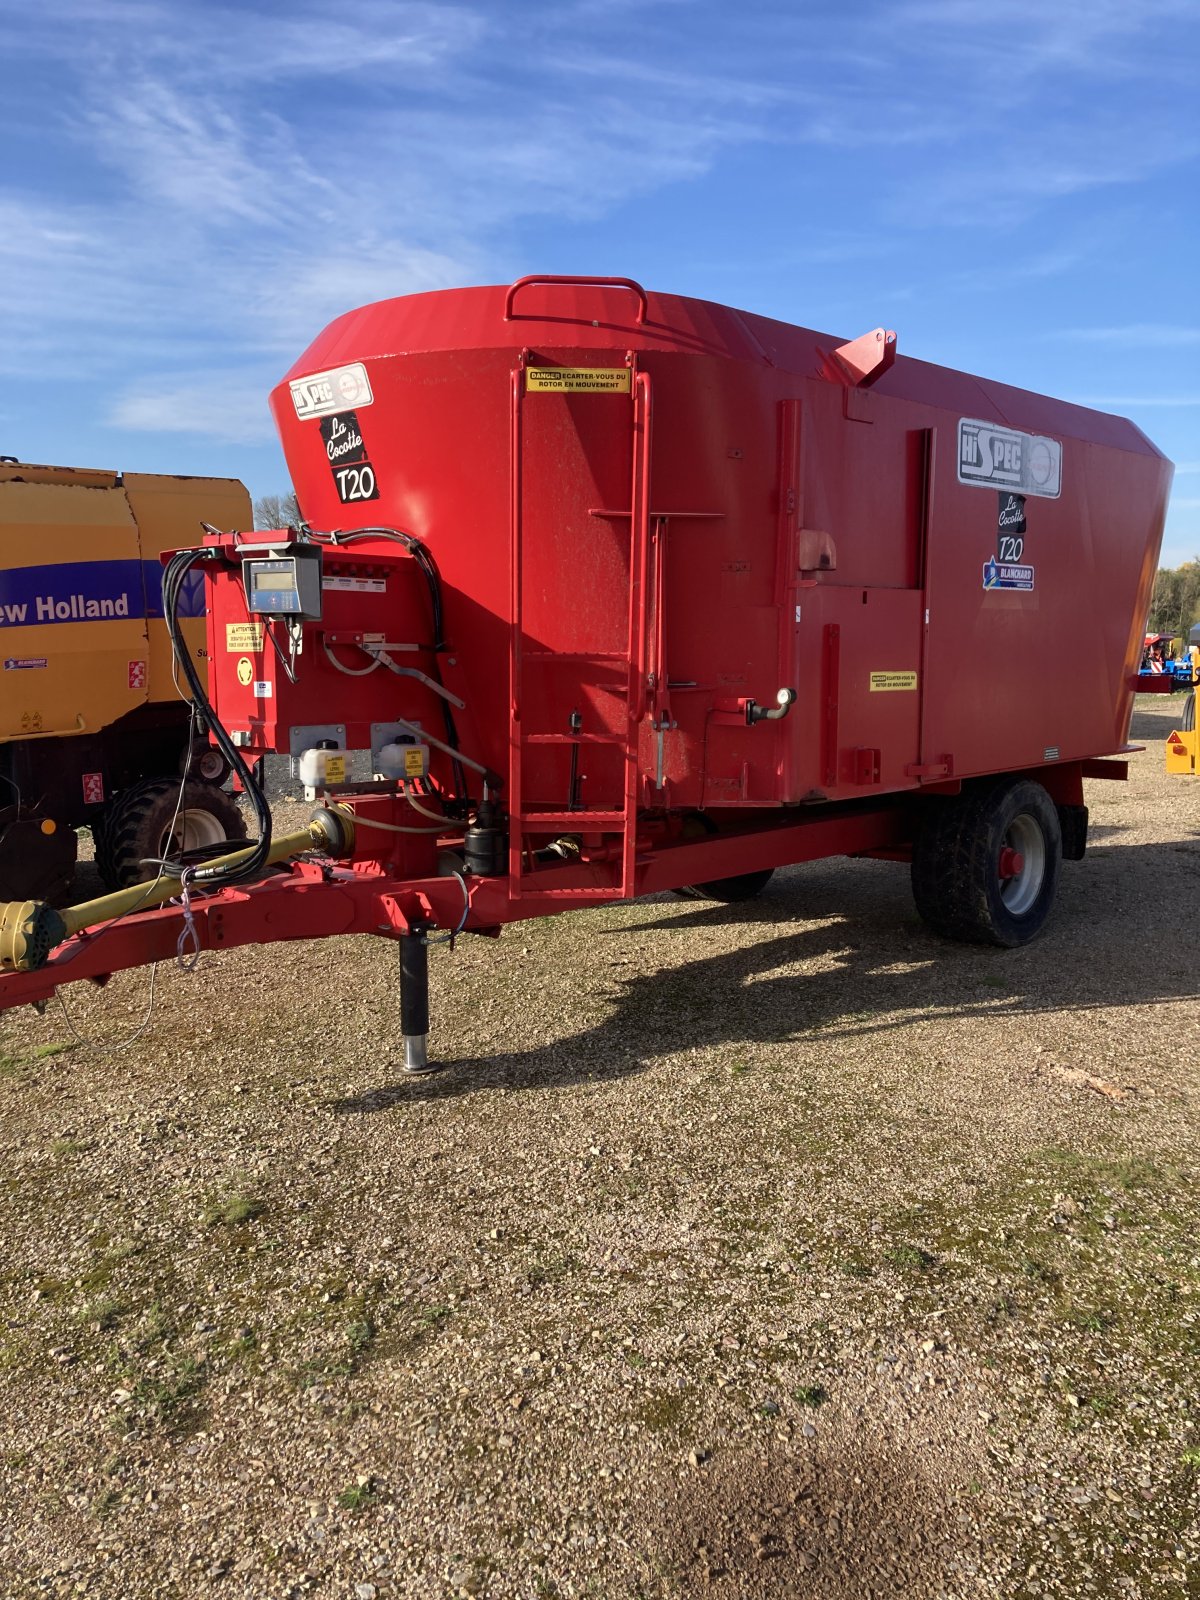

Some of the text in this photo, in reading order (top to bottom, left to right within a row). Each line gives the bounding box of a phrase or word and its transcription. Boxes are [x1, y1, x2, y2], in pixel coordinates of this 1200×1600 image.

[531, 371, 560, 379] DANGER
[575, 381, 619, 389] MOUVEMENT
[331, 417, 347, 440] La
[327, 430, 362, 460] Cocotte
[337, 467, 374, 500] T20
[1005, 495, 1017, 511] La
[998, 510, 1024, 527] Cocotte
[1000, 536, 1024, 562] T20
[1000, 567, 1032, 580] BLANCHARD
[36, 593, 128, 620] Holland
